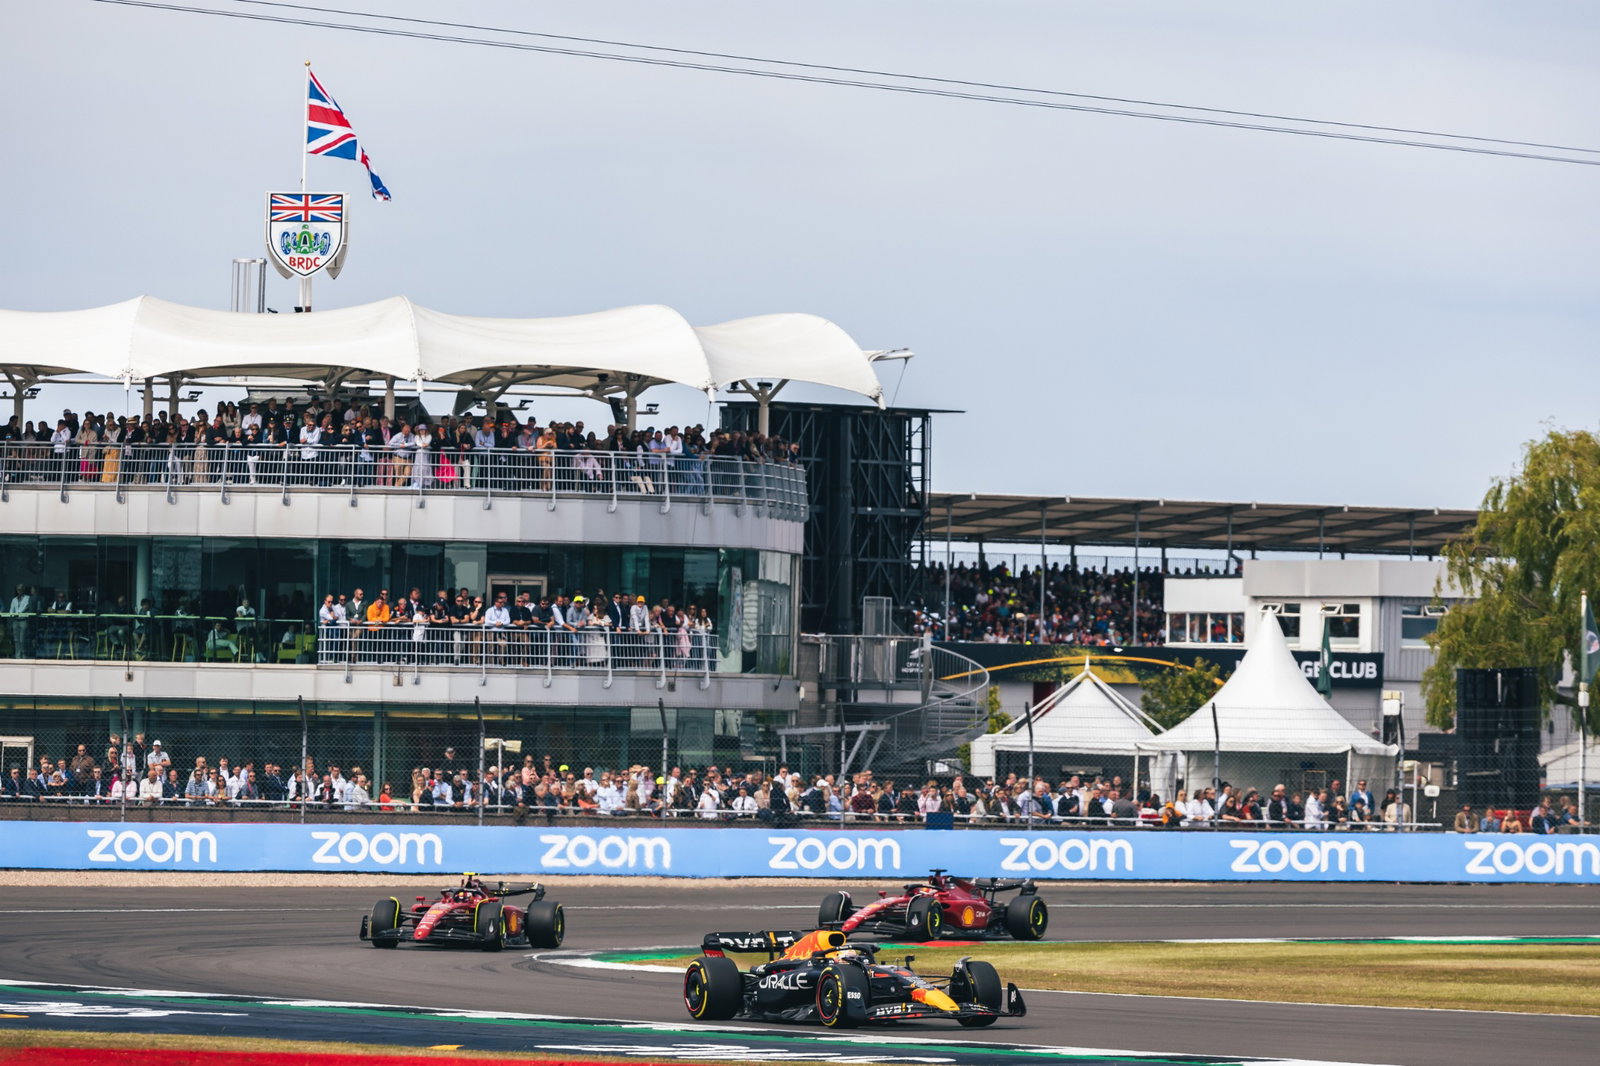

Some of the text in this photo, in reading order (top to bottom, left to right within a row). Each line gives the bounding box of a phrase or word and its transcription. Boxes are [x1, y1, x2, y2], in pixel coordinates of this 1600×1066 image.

[288, 256, 321, 270] BRDC
[1329, 661, 1378, 679] CLUB
[86, 829, 217, 863] zoom
[311, 831, 443, 865] zoom
[540, 834, 672, 869] zoom
[768, 836, 901, 870] zoom
[999, 837, 1133, 872] zoom
[1230, 839, 1365, 874] zoom
[1464, 841, 1600, 876] zoom
[758, 972, 813, 990] ORACLE
